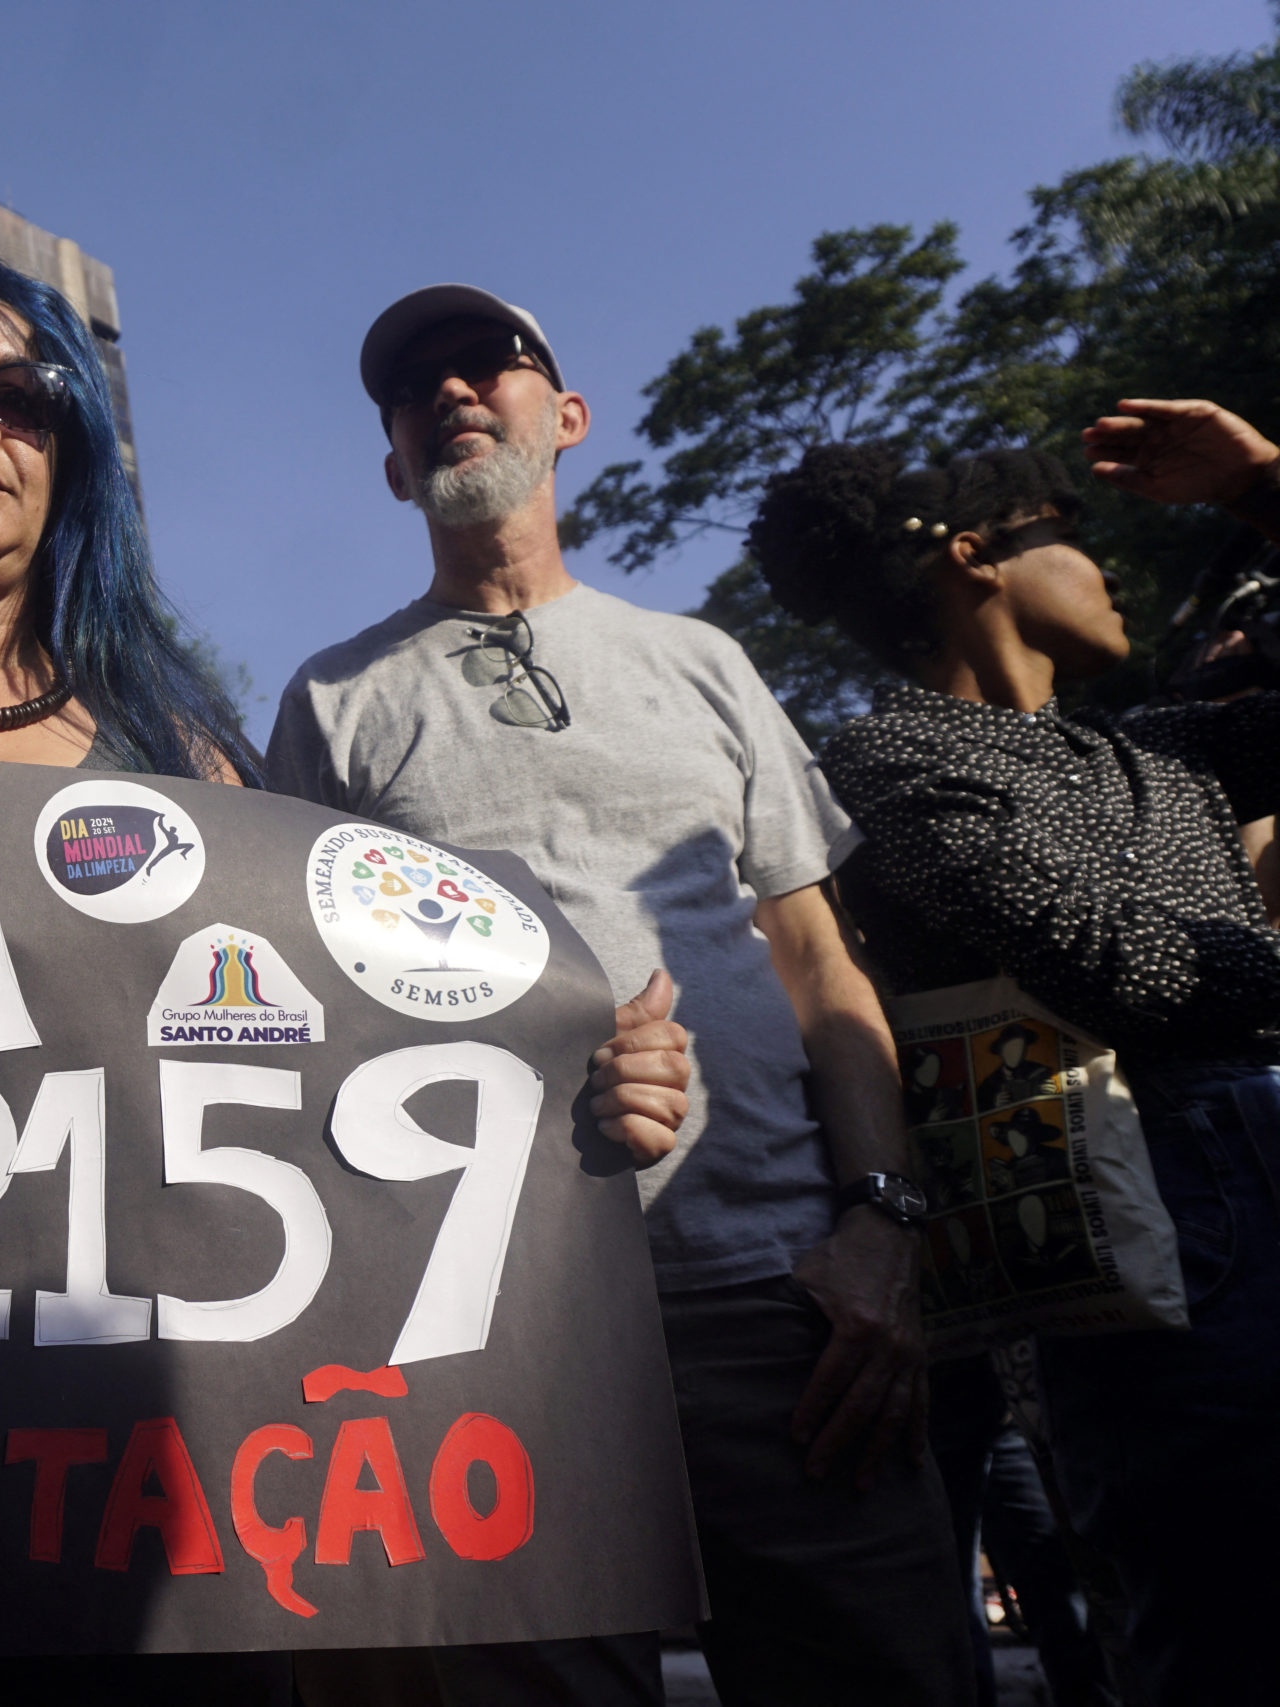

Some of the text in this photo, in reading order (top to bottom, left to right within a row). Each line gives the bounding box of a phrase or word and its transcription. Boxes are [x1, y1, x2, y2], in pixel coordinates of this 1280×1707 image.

[60, 818, 113, 841] DIA 2024
[103, 826, 116, 834] SET
[64, 834, 147, 863] MUNDIAL
[67, 857, 136, 879] DA LIMPEZA
[315, 827, 538, 934] SEMEANDO SUSTENTABILIDADE
[390, 978, 494, 1006] SEMSUS
[162, 1008, 308, 1023] Grupo Mulheres do Brasil
[160, 1023, 311, 1043] SANTO ANDRÉ
